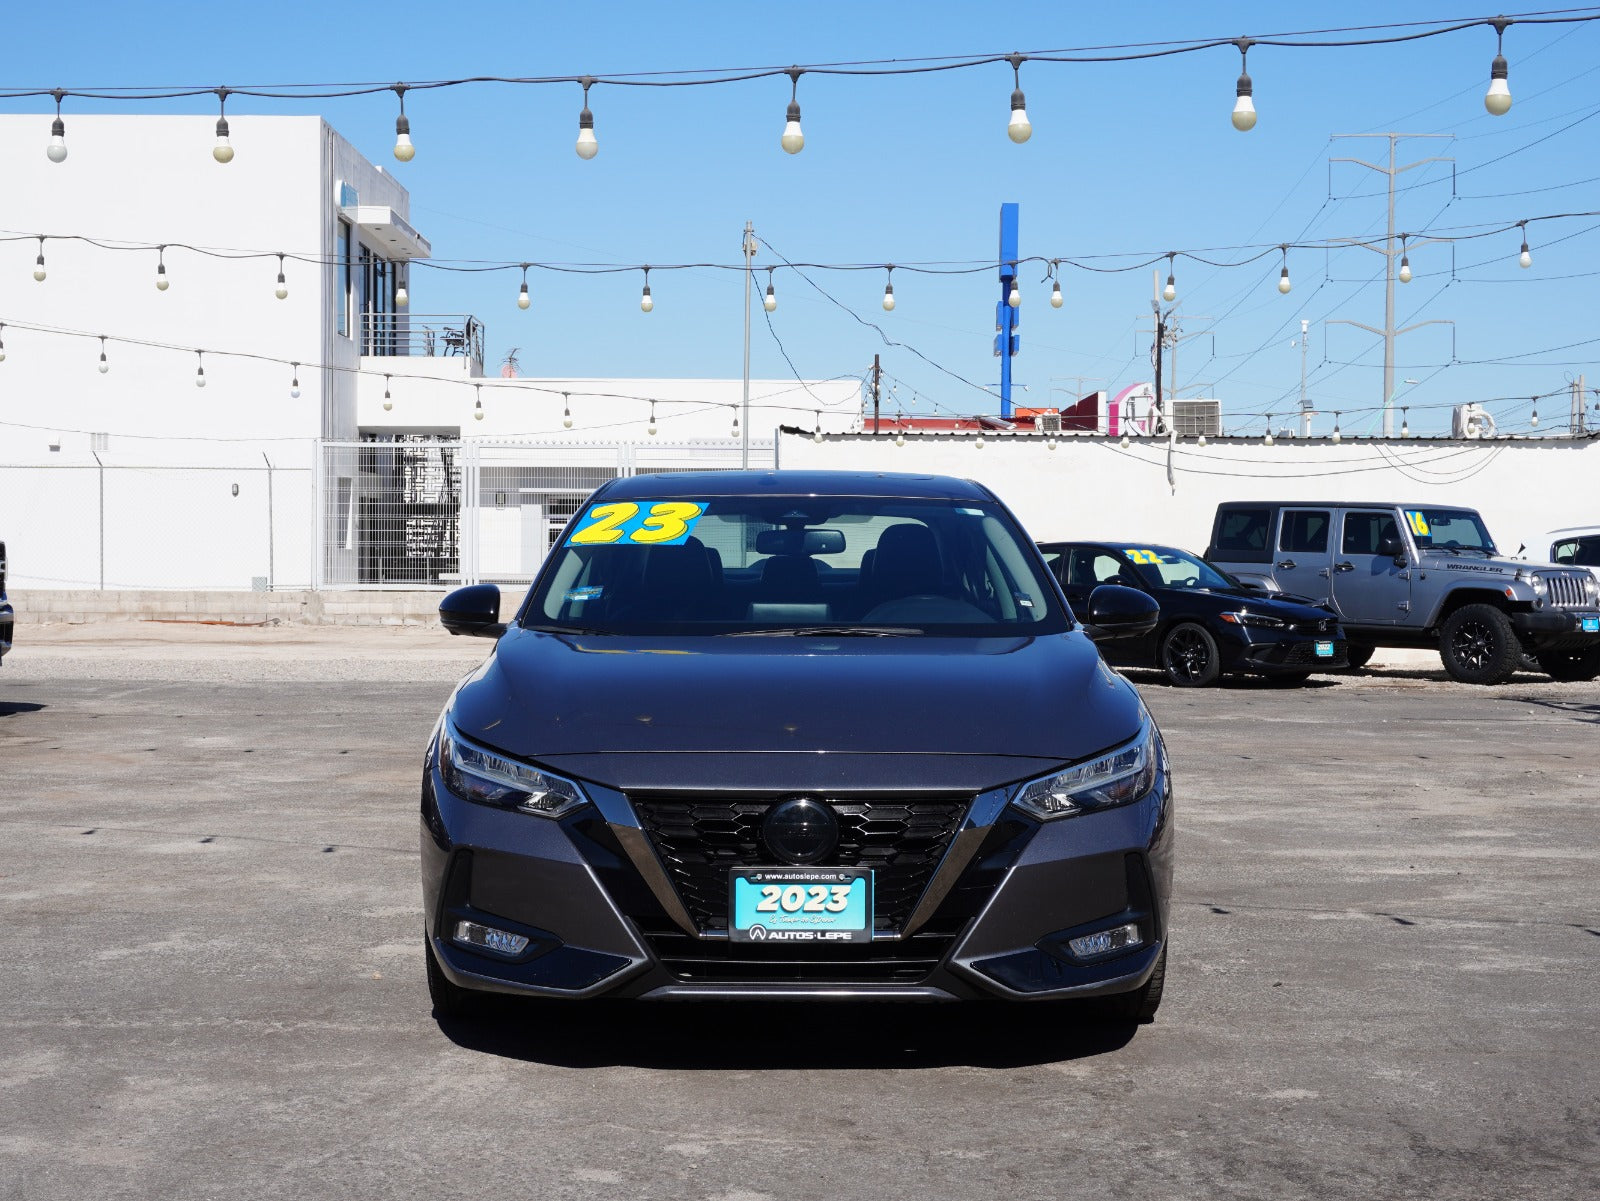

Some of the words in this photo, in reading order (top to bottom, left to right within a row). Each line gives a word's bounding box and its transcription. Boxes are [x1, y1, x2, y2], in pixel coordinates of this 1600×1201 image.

[571, 502, 702, 544] 23
[1406, 511, 1429, 536] 16
[1126, 549, 1164, 564] 22
[1446, 563, 1504, 573] WRANGLER
[764, 873, 837, 881] www.autoslepe.com
[756, 885, 852, 912] 2023
